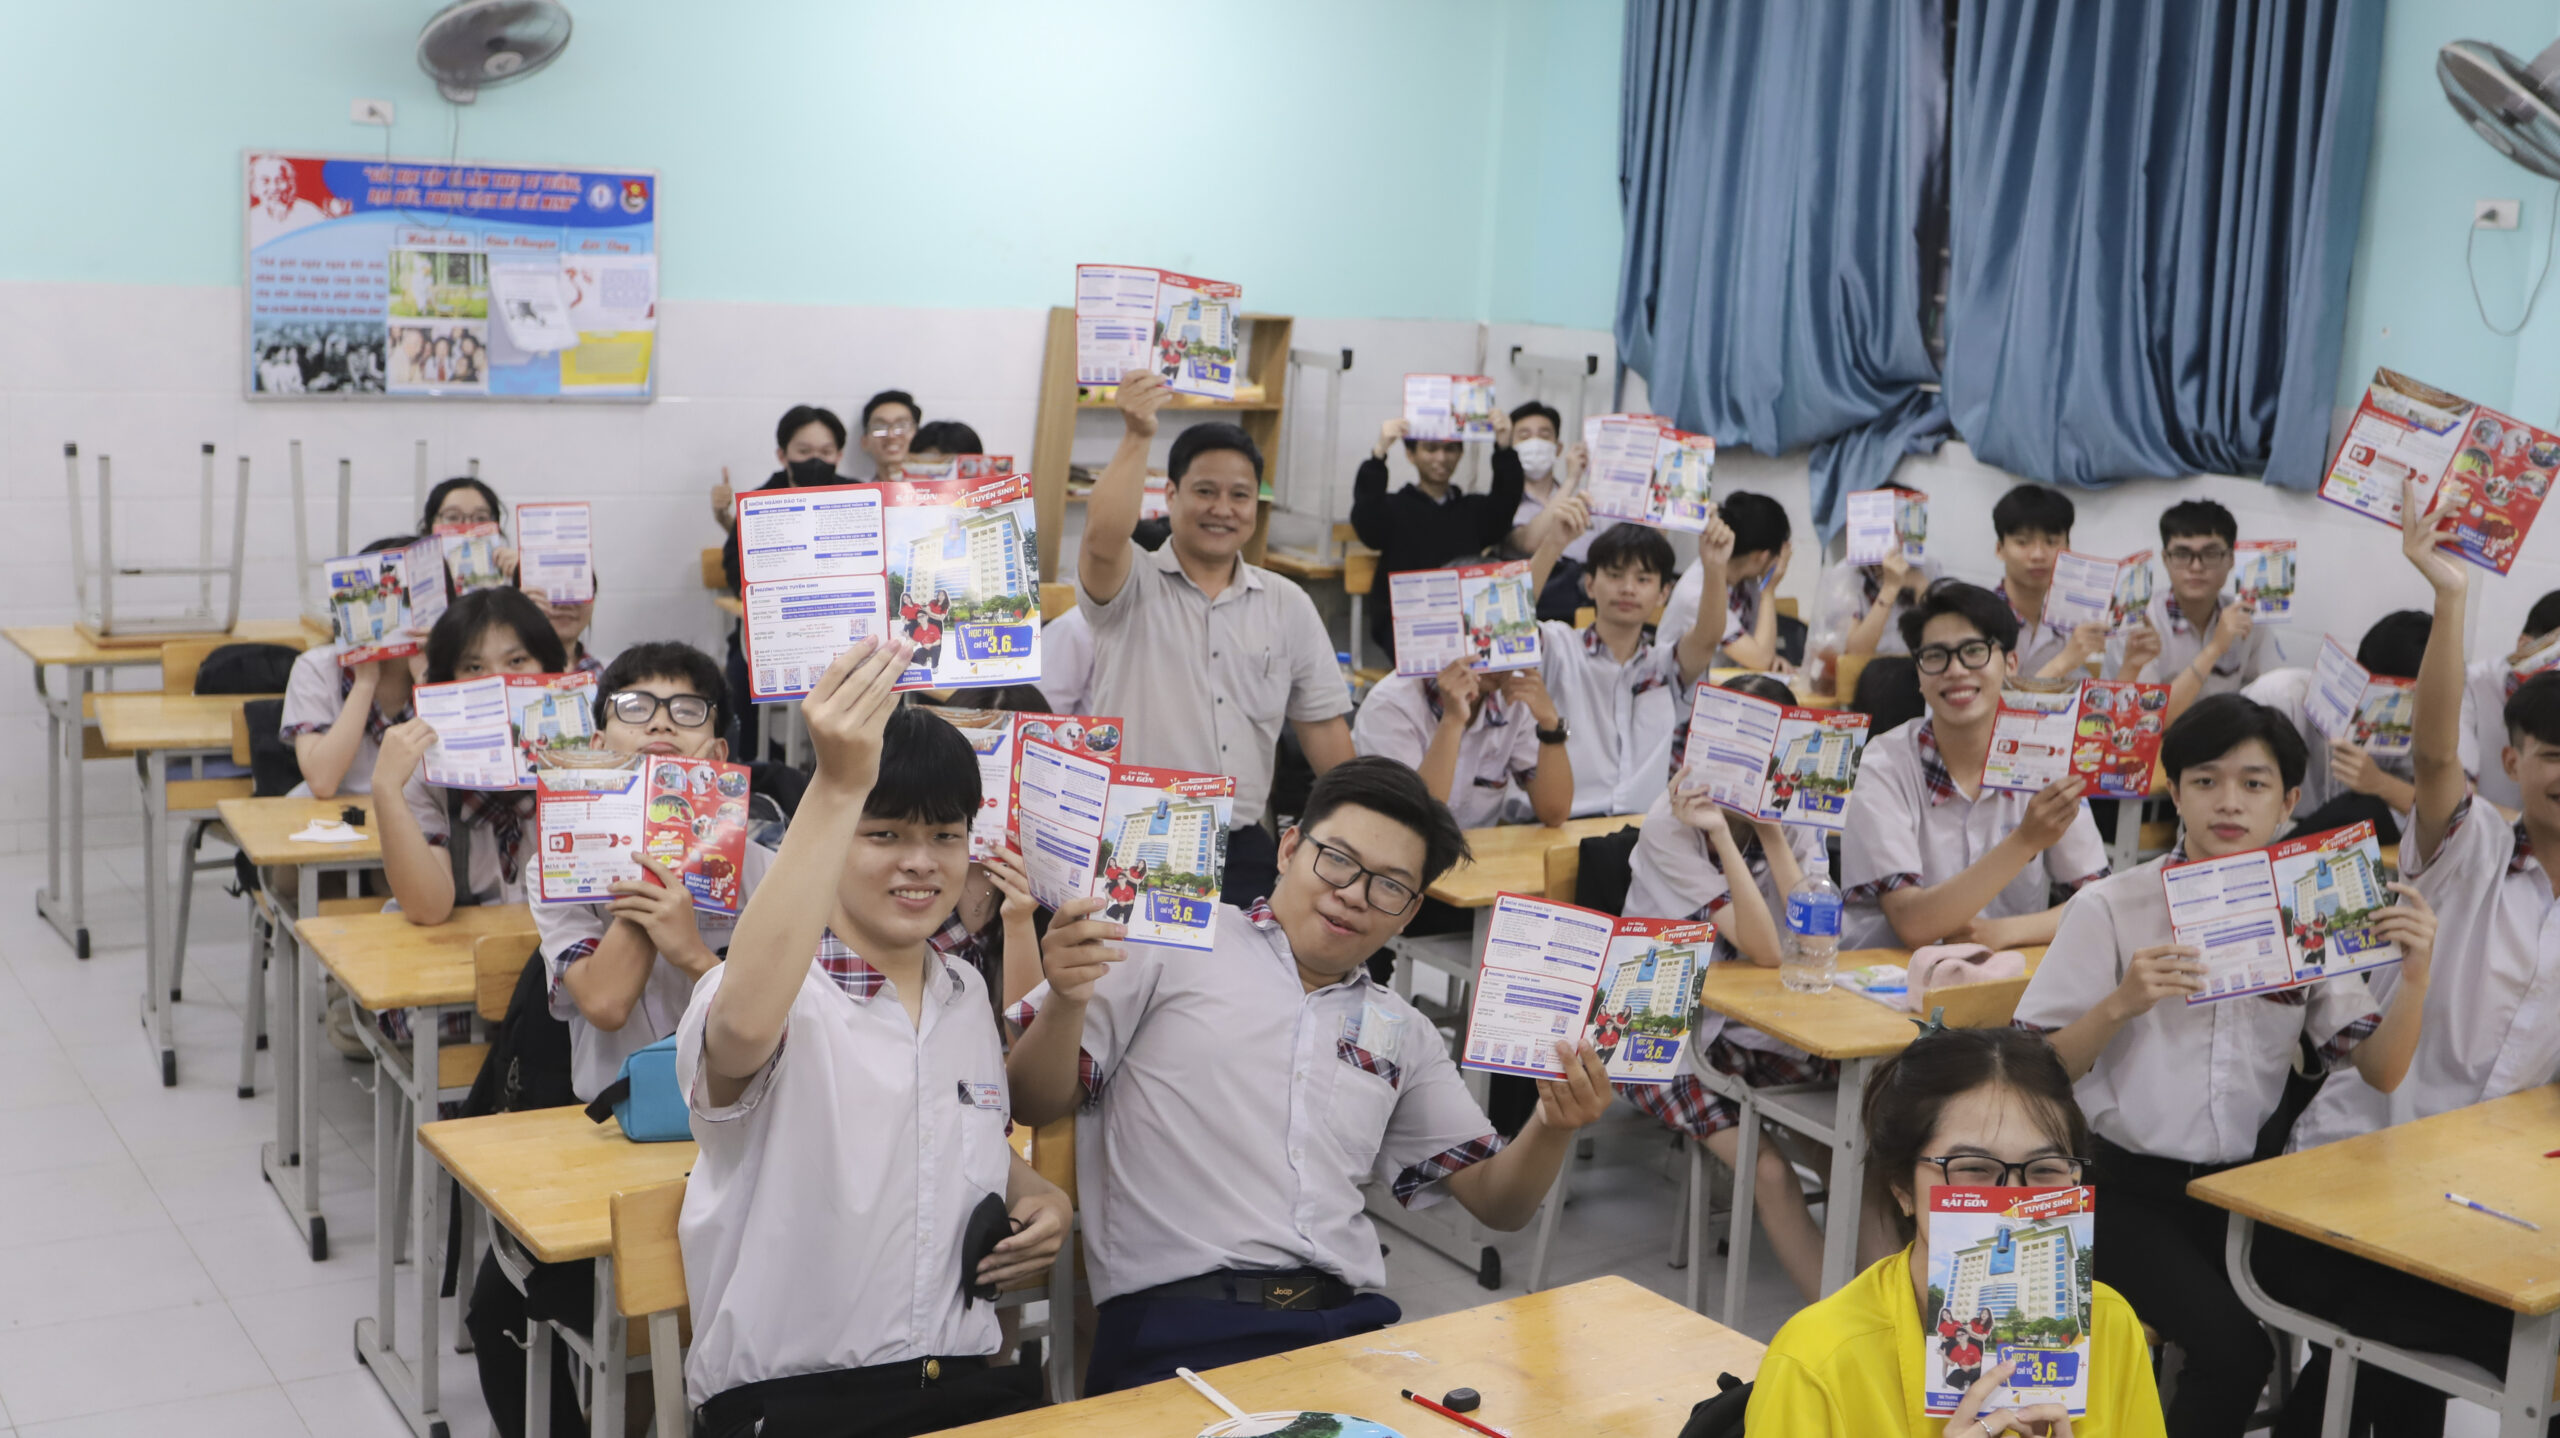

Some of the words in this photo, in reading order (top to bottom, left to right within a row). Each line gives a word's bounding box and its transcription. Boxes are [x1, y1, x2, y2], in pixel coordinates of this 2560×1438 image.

[997, 486, 1015, 498] SINH
[988, 634, 1012, 655] 3,6
[1172, 904, 1193, 922] 3,6
[1645, 1044, 1664, 1060] 3,6
[2052, 1197, 2073, 1209] SINH
[2032, 1361, 2057, 1384] 3,6
